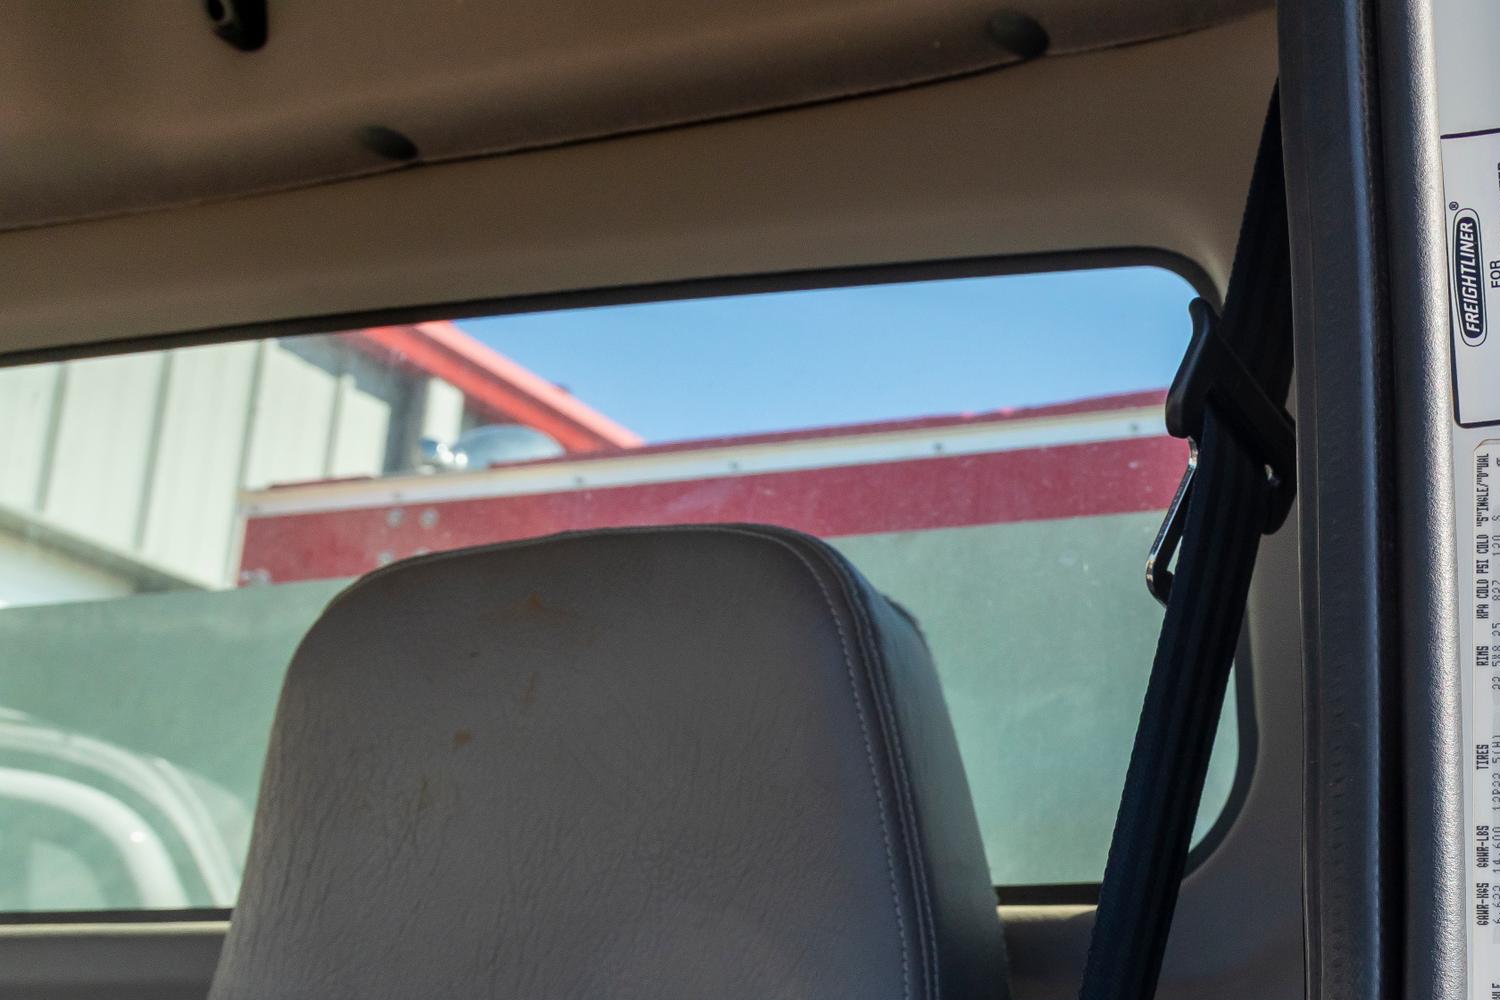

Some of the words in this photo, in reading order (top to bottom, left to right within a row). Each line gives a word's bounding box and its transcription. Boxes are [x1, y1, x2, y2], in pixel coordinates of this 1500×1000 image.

[1457, 222, 1481, 333] FREIGHTLINER
[1495, 457, 1500, 466] A
[1476, 534, 1489, 554] COLD
[1476, 560, 1489, 574] PSI
[1476, 579, 1489, 598] COLD
[1476, 604, 1489, 619] KPA
[1476, 646, 1489, 666] RIMS
[1476, 744, 1489, 770] TIRES
[1476, 825, 1490, 868] GAWR-LBS
[1476, 882, 1490, 926] GAWR-KGS
